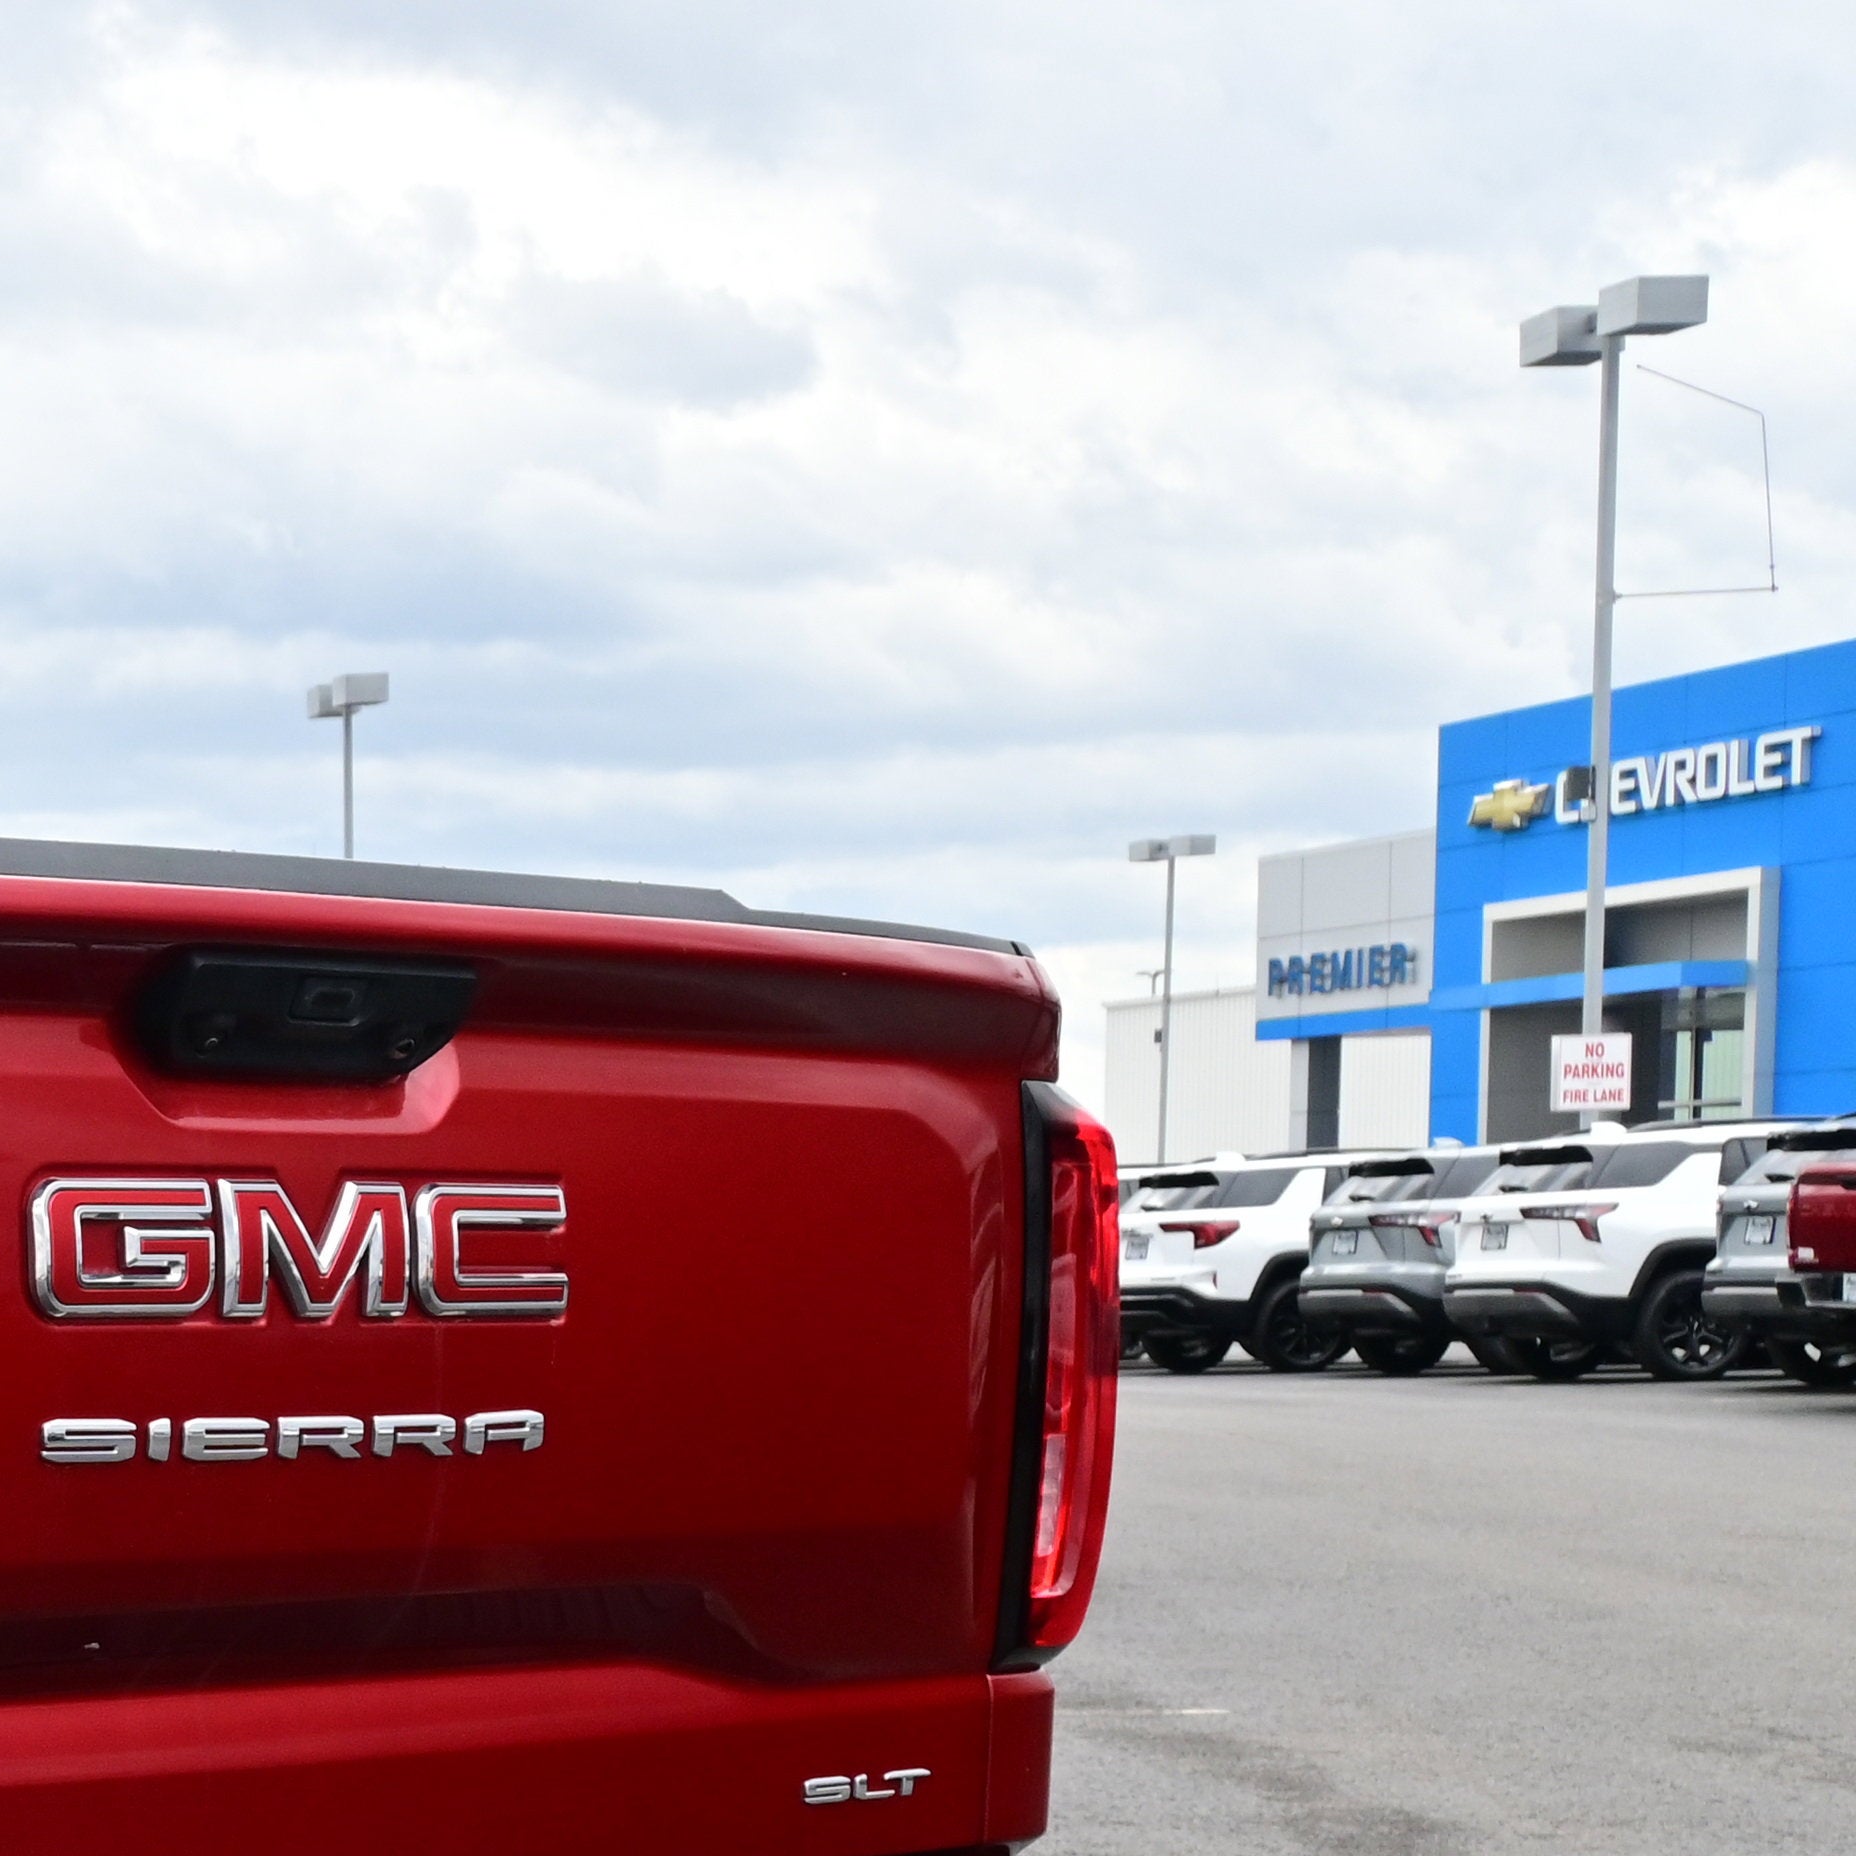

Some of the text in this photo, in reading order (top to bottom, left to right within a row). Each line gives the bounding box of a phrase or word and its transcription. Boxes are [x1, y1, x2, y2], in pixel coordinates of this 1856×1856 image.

[1555, 726, 1821, 824] CEVROLET
[1267, 942, 1409, 997] PREMIER
[1563, 1062, 1624, 1079] PARKING
[1585, 1042, 1605, 1058] NO
[1563, 1088, 1624, 1103] FIRE LANE
[30, 1177, 569, 1318] GMC
[41, 1409, 545, 1462] SIERRA
[803, 1767, 933, 1805] SLT
